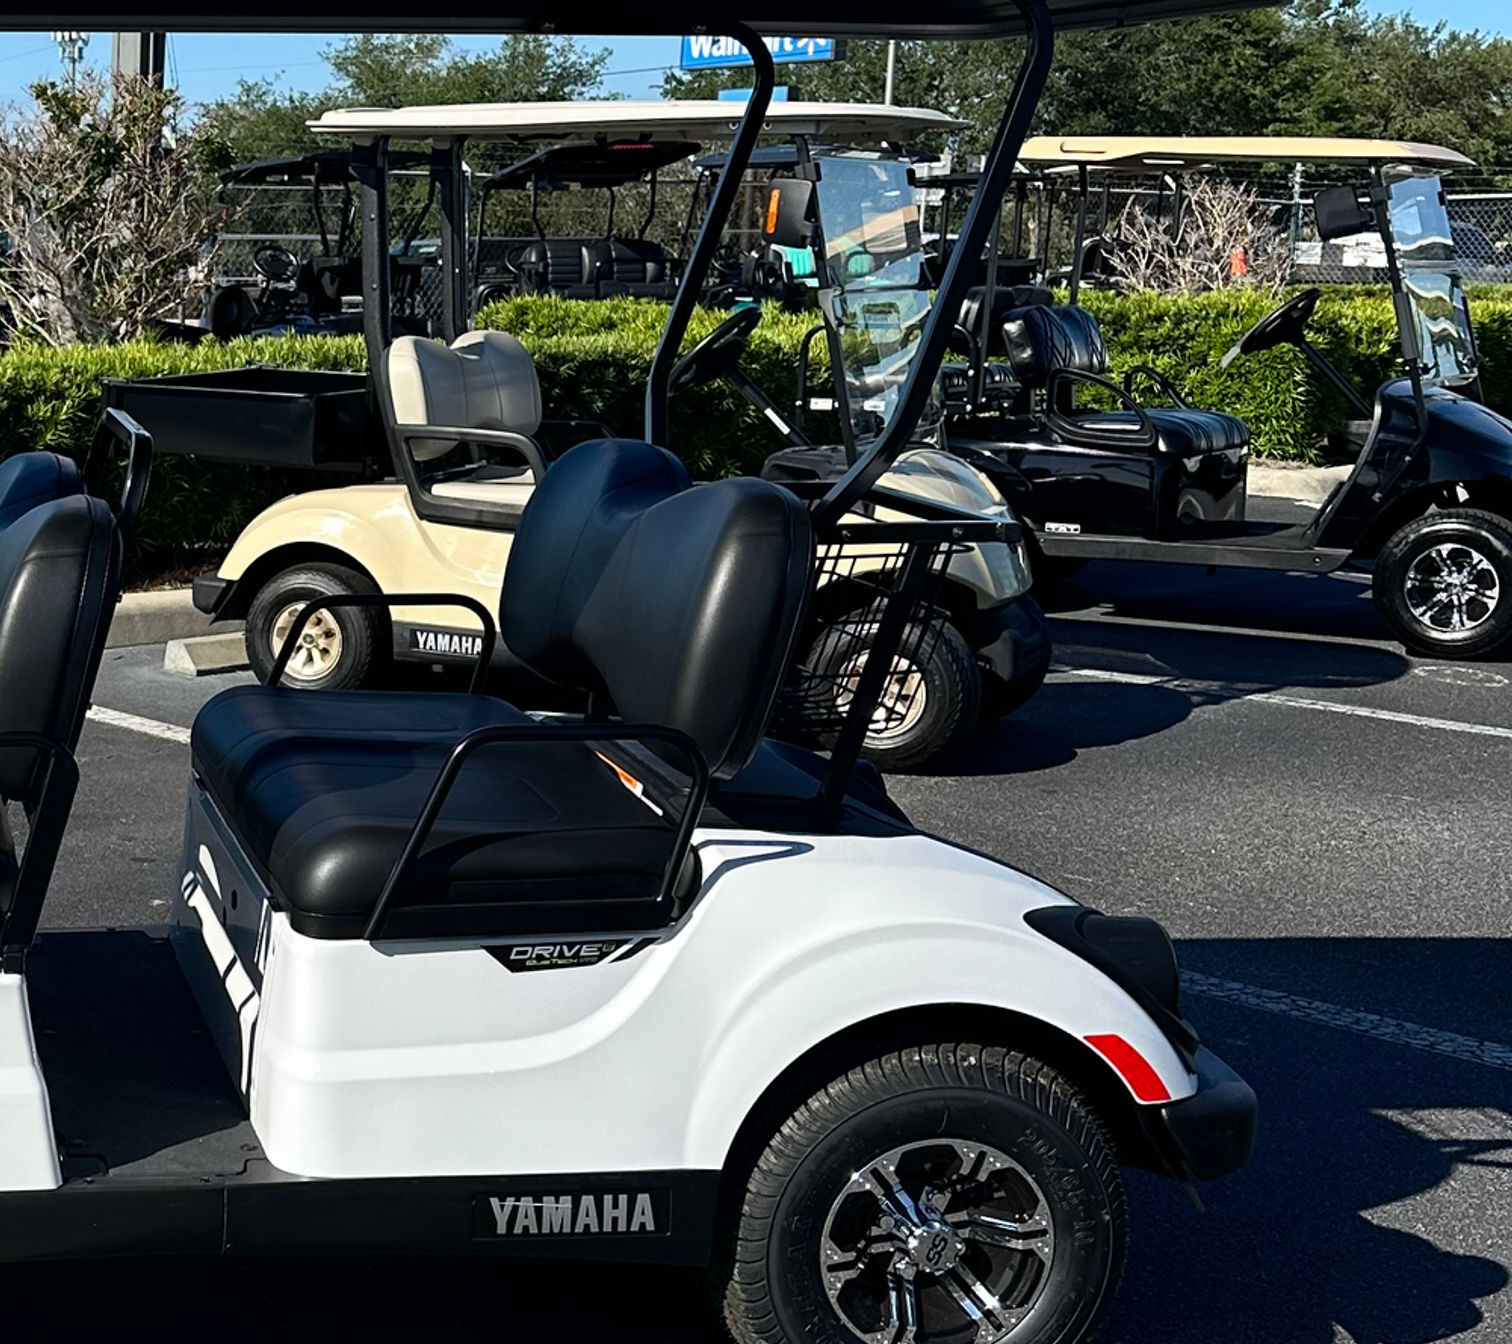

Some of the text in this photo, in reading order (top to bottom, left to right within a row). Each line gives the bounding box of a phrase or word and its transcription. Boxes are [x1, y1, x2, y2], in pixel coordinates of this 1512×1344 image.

[689, 36, 793, 59] Walrt
[416, 631, 483, 655] YAMAHA
[510, 943, 603, 960] DRIVE
[489, 1193, 656, 1235] YAMAHA
